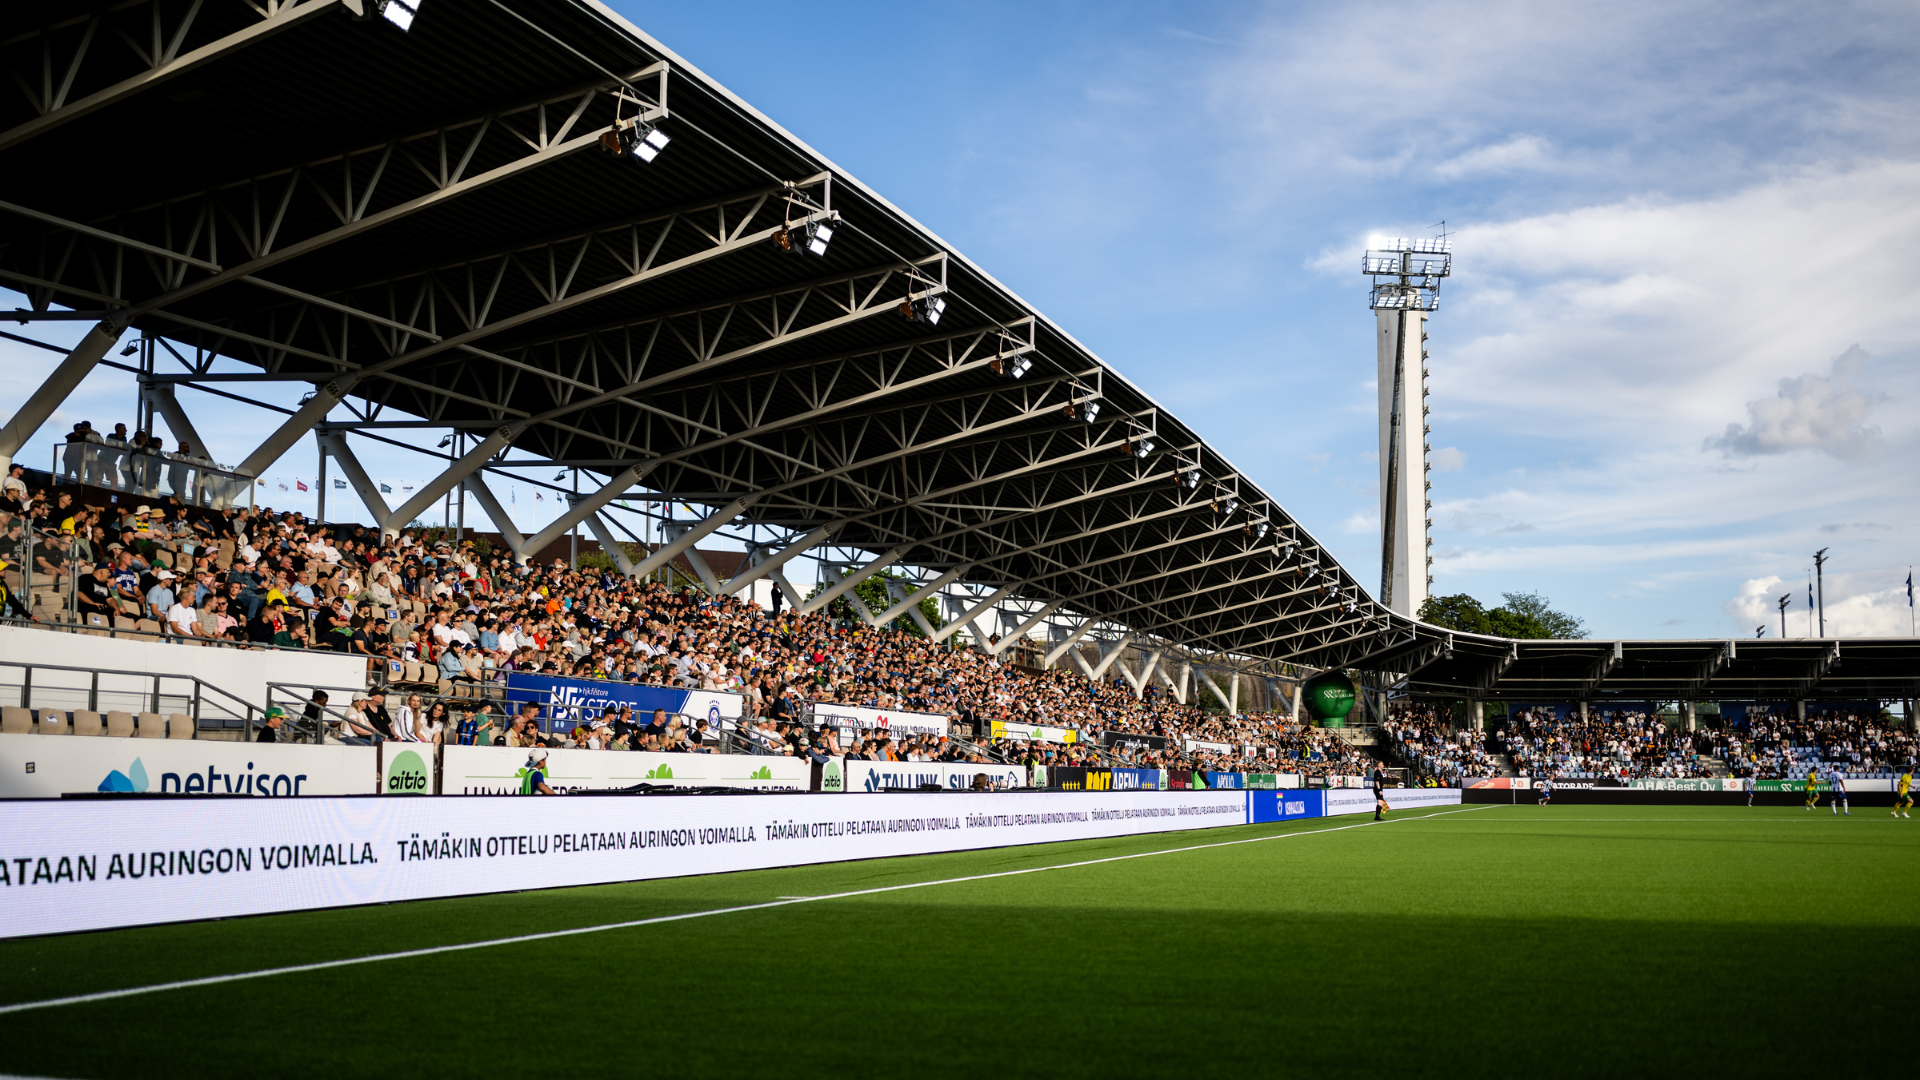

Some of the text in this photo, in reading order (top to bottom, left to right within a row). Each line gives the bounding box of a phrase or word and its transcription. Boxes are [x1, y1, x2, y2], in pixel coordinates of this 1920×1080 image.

[161, 761, 307, 796] netvisor
[389, 770, 426, 790] aitio
[824, 775, 841, 788] aitio
[106, 848, 251, 880] AURINGON
[260, 842, 378, 870] VOIMALLA.
[397, 832, 481, 861] TÄMÄKIN
[487, 835, 548, 857] OTTELU
[554, 832, 626, 853] PELATAAN
[629, 829, 696, 849] AURINGON
[699, 826, 757, 845] VOIMALLA.
[766, 819, 809, 840] TÄMÄKIN
[812, 821, 844, 838] OTTELU
[847, 820, 886, 836] PELATAAN
[888, 818, 925, 833] AURINGON
